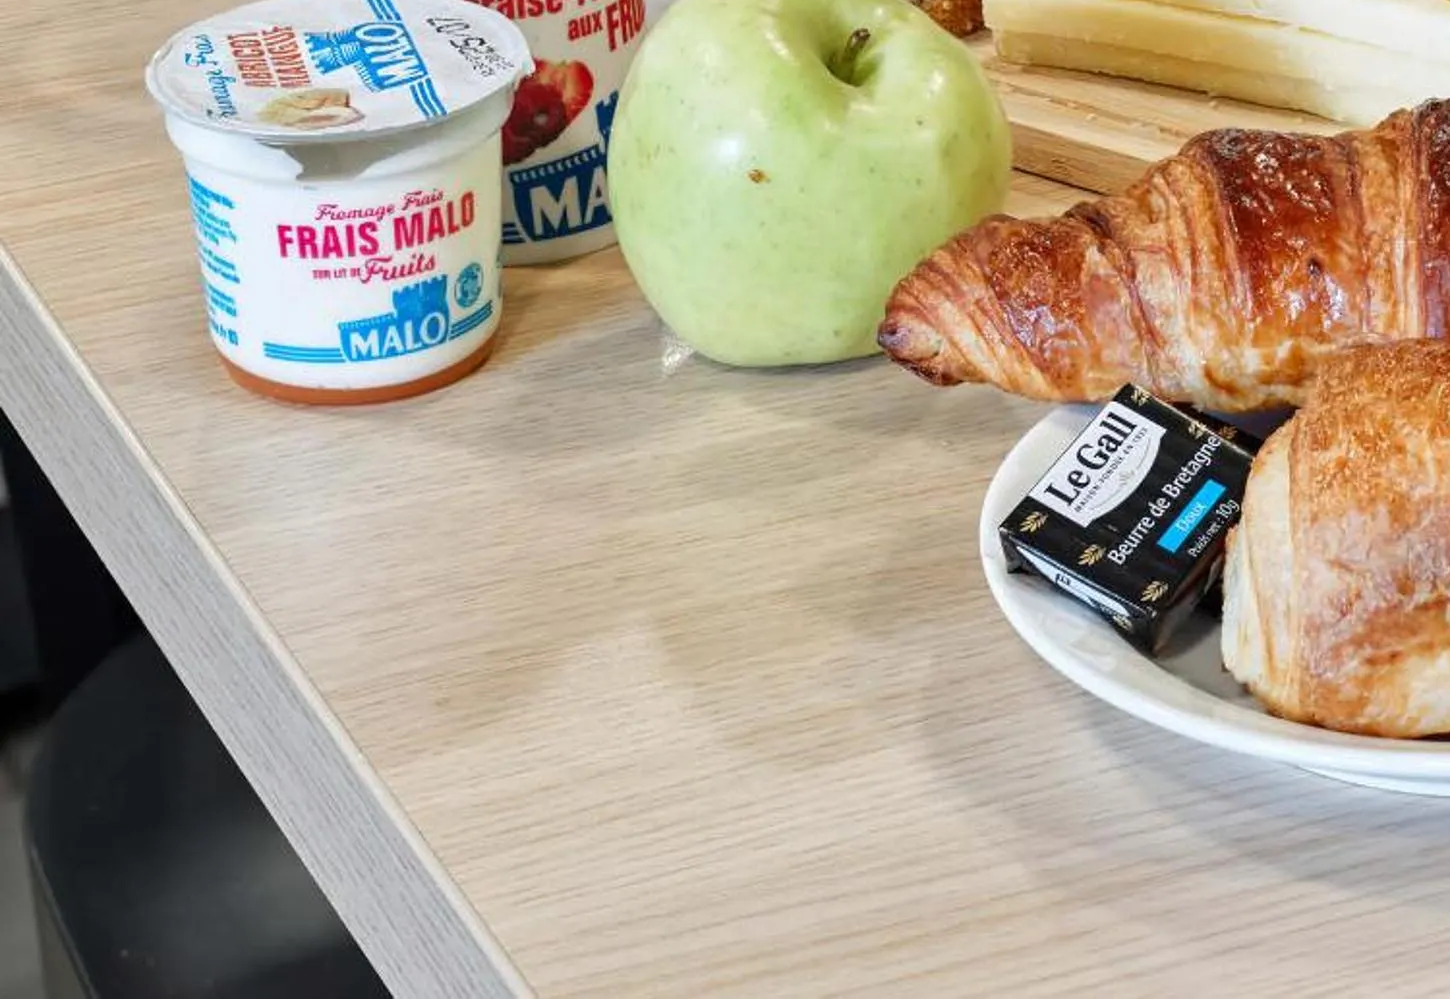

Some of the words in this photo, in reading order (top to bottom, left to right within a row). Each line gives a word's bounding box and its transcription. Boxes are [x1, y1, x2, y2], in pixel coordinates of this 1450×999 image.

[568, 11, 602, 40] aux
[228, 31, 277, 88] ABRICOT
[262, 26, 311, 88] MANGUE
[355, 23, 425, 86] MALO
[277, 221, 379, 259] FRAIS
[393, 191, 475, 250] MALO
[315, 203, 394, 221] Fromage
[401, 188, 444, 210] Frais
[529, 165, 613, 235] MA
[360, 253, 436, 284] Fruits
[350, 312, 446, 359] MALO
[1107, 515, 1155, 566] Beurre
[1150, 497, 1171, 518] de
[1161, 435, 1222, 498] Bretagne
[1176, 502, 1207, 532] Doux
[1215, 499, 1240, 519] 10g
